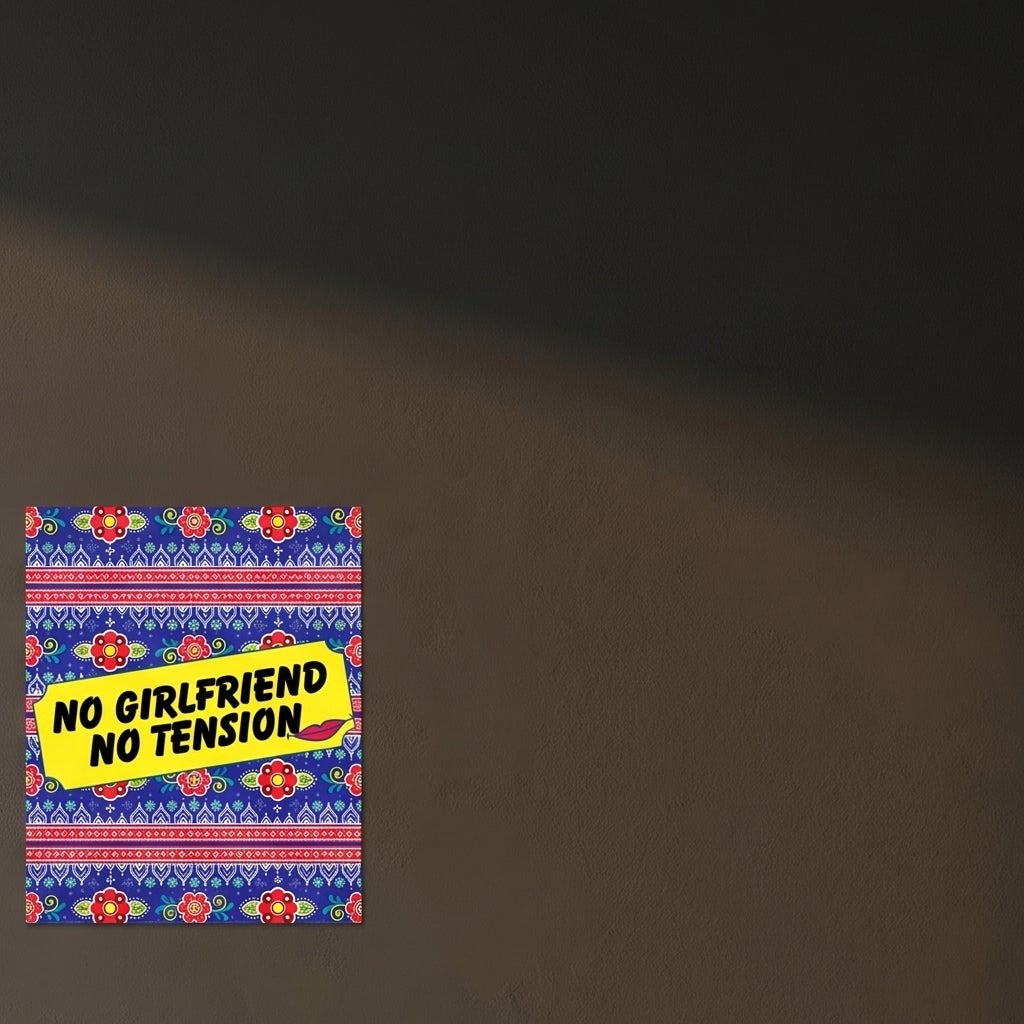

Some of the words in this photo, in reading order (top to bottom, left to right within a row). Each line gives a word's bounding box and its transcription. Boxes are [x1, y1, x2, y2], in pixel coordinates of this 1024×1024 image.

[53, 696, 102, 733] NO
[116, 661, 327, 724] GIRLFRIEND
[90, 729, 140, 767] NO
[151, 703, 302, 756] TENSION
